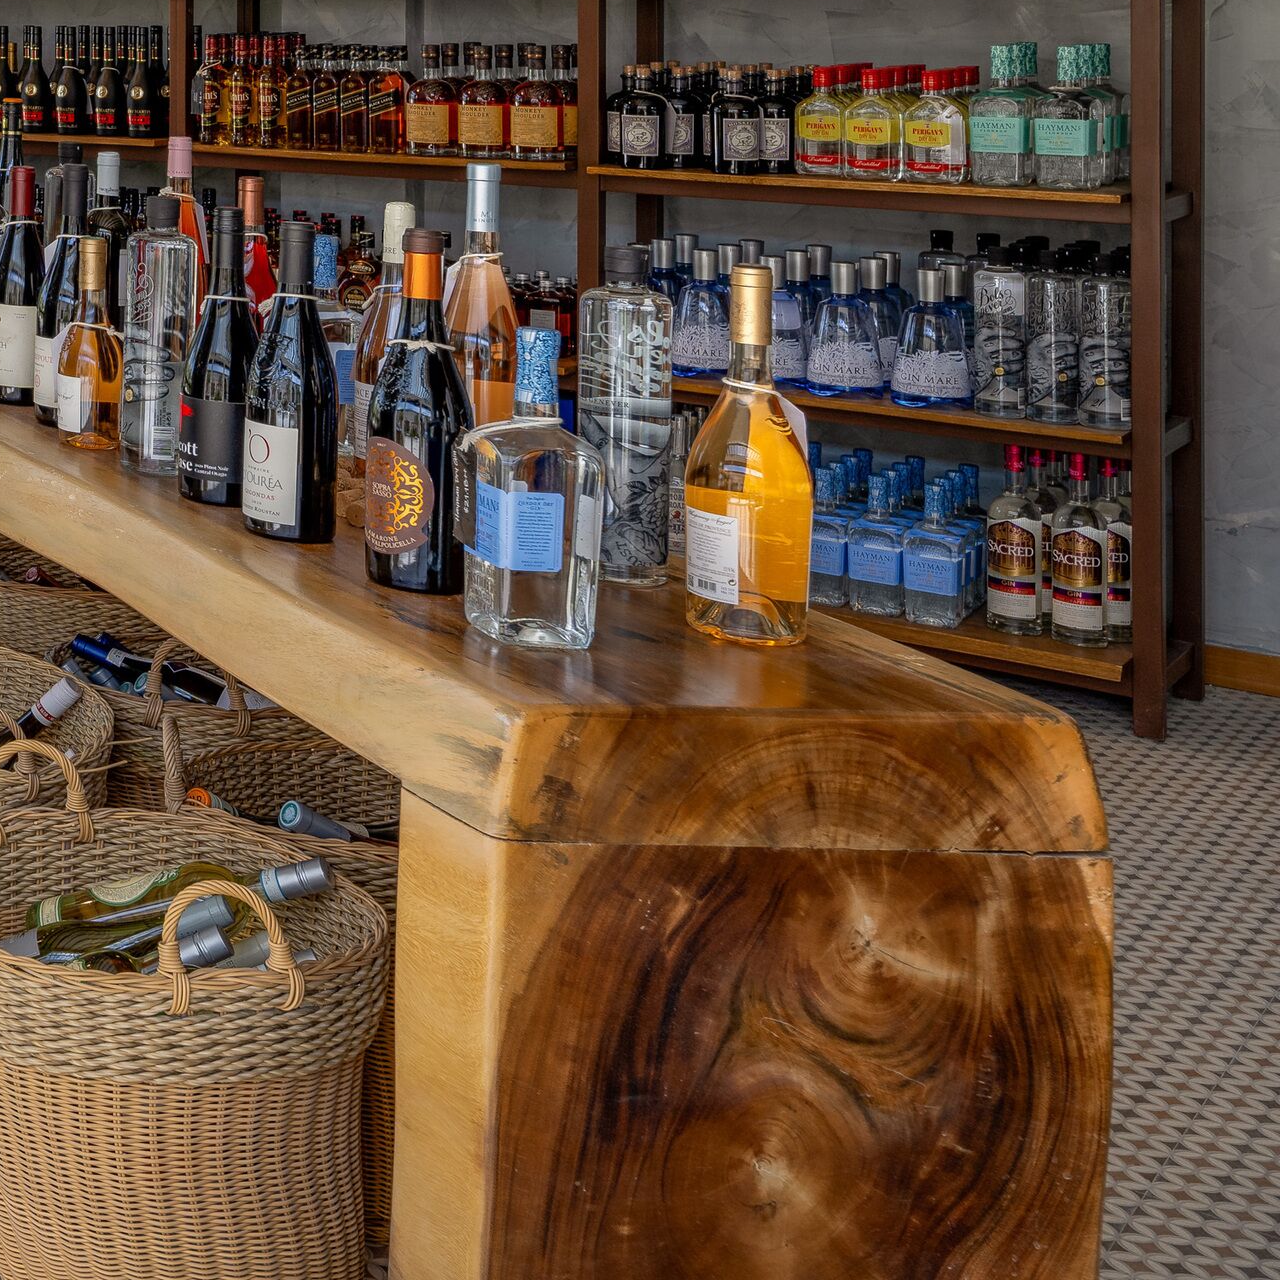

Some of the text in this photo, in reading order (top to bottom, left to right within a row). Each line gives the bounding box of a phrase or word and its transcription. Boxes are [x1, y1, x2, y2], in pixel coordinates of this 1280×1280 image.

[673, 347, 724, 358] GIN MARE
[812, 363, 868, 375] GIN MARE
[901, 373, 959, 386] GIN MARE
[179, 440, 198, 456] cott
[987, 538, 1034, 558] SACRED
[1052, 550, 1101, 568] SACRED
[1001, 579, 1016, 587] GIN
[1066, 590, 1083, 598] GIN
